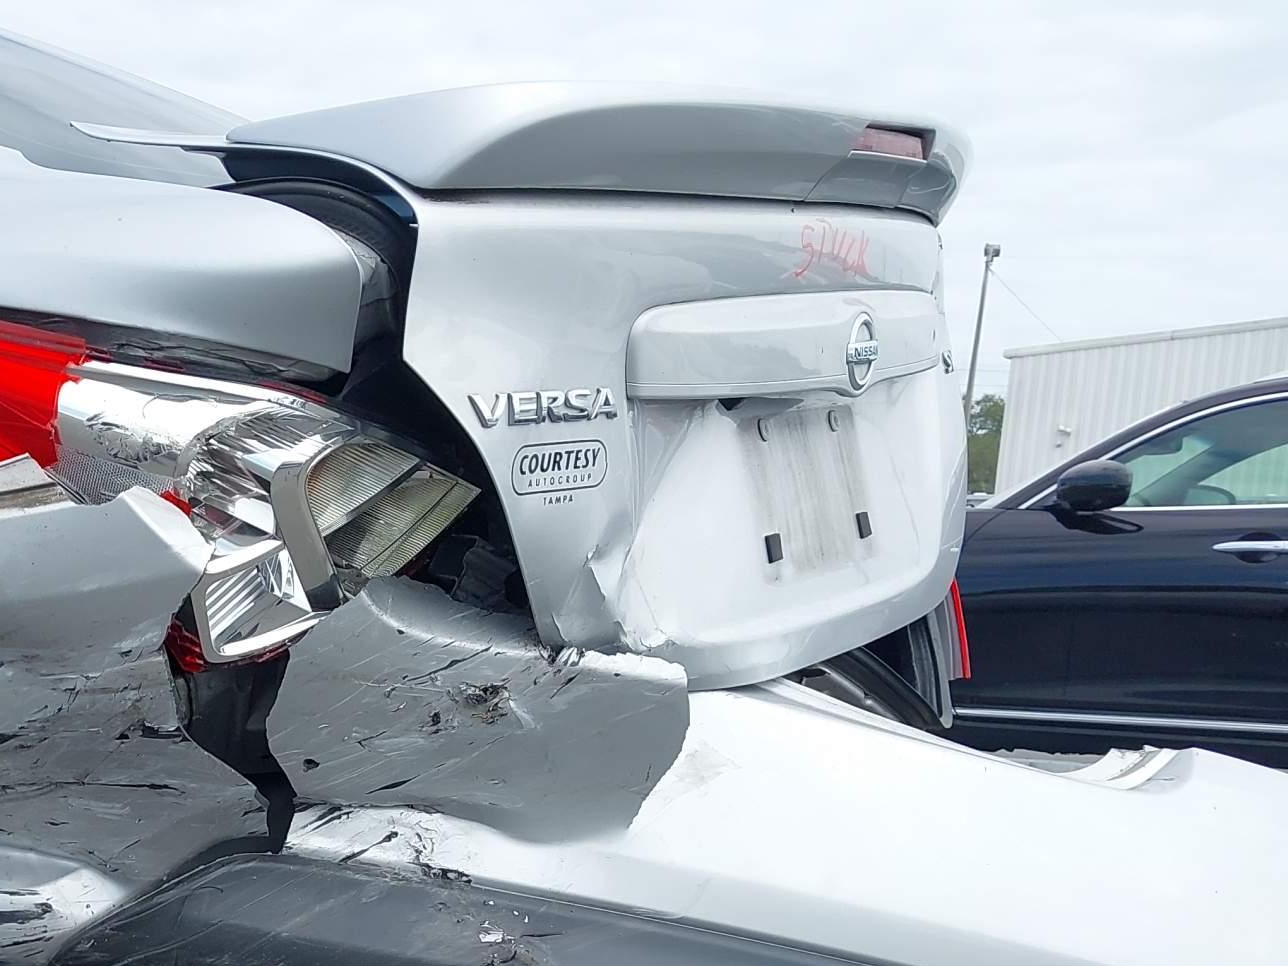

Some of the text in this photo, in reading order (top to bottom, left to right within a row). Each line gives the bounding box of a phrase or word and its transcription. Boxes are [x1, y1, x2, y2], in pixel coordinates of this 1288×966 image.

[467, 387, 618, 429] VERSA
[519, 447, 601, 476] COURTESY
[543, 494, 574, 507] TAMPA
